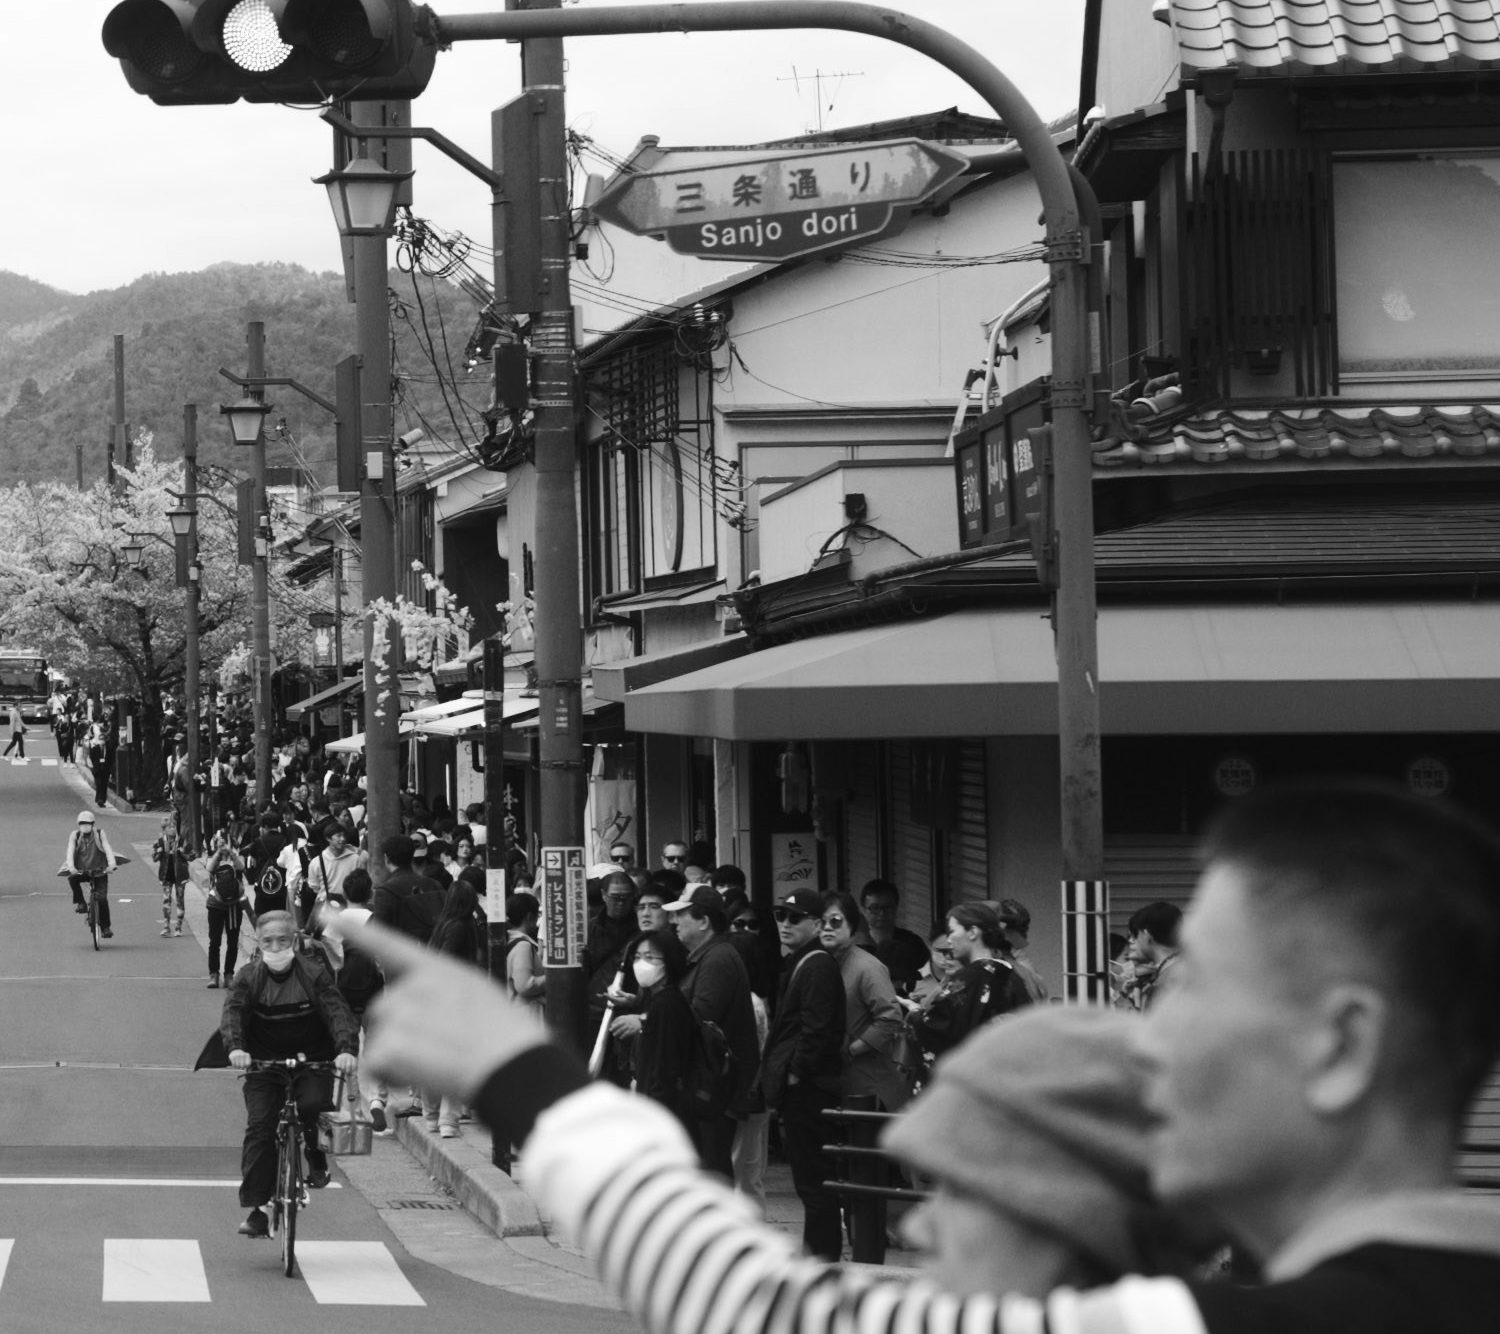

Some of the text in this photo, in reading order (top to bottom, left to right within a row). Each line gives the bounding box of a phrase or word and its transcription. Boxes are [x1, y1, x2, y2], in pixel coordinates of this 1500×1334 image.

[676, 161, 870, 214] 三条通り
[701, 207, 857, 247] Sanjo dori
